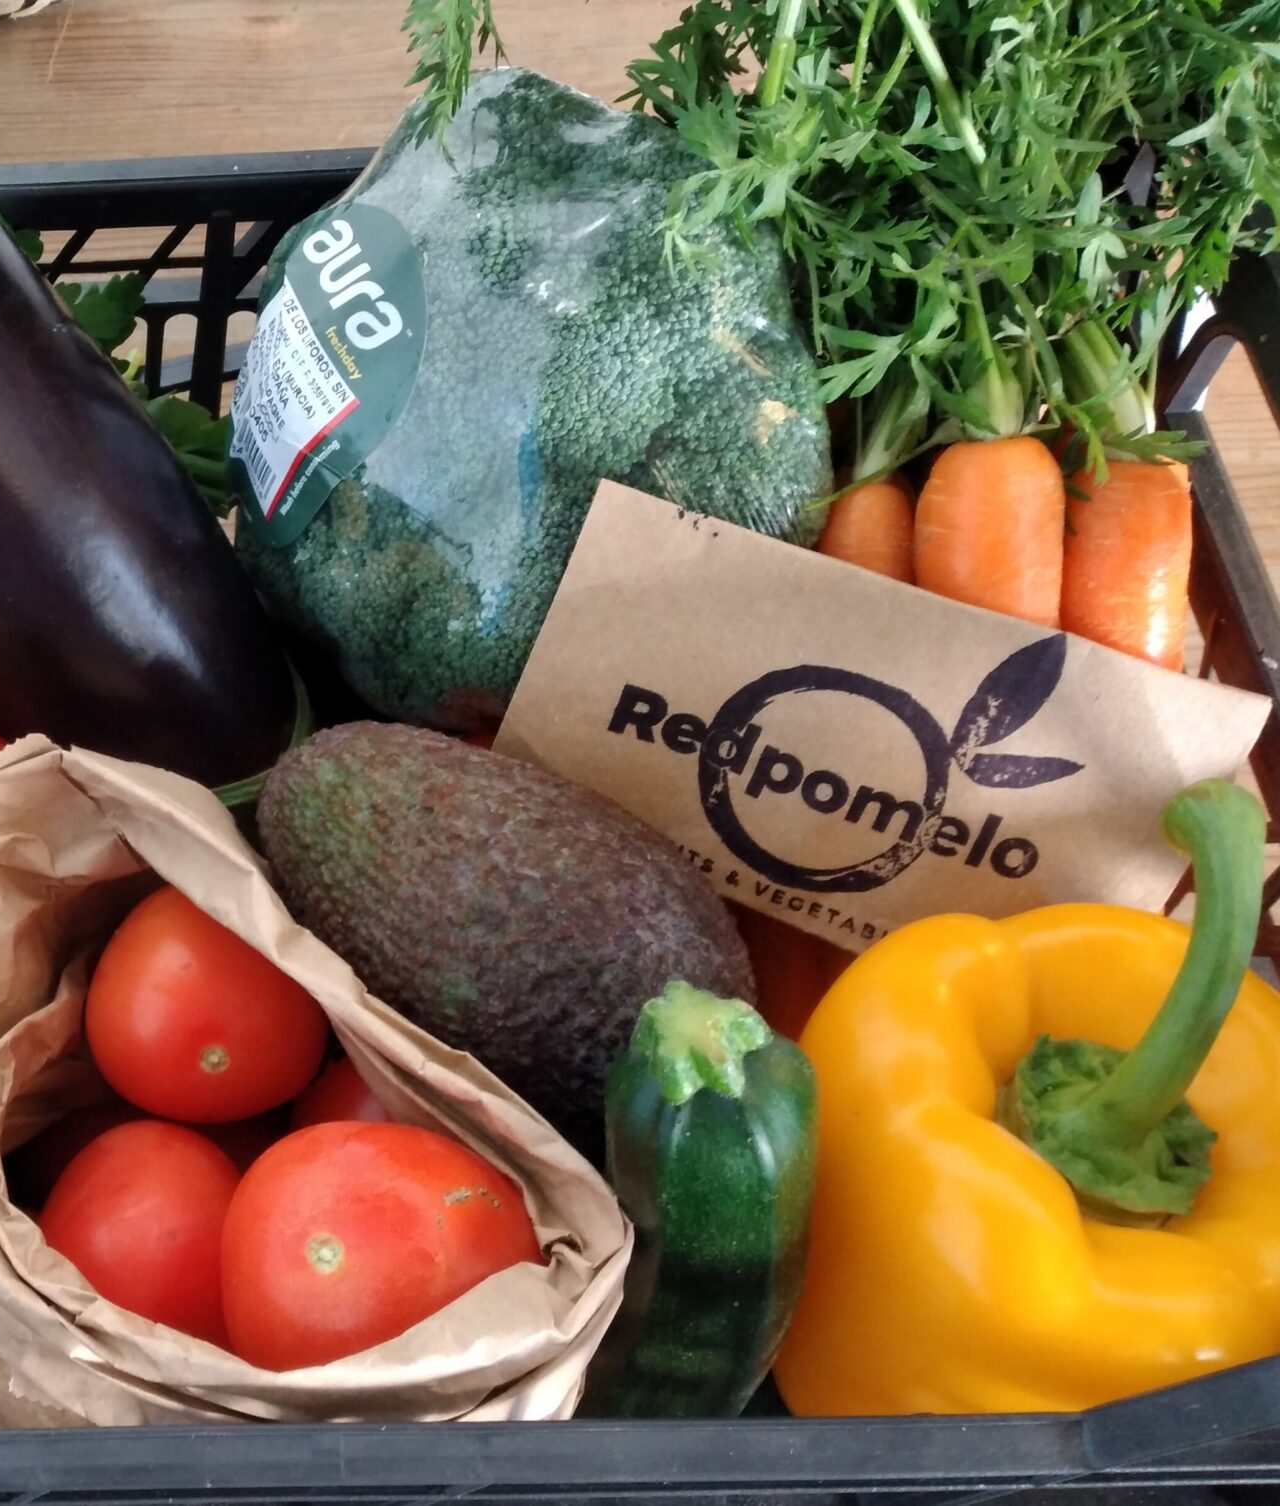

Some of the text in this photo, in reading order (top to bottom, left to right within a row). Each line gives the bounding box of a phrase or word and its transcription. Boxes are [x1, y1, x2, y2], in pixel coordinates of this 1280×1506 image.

[283, 298, 298, 315] DE
[302, 219, 404, 350] aura
[290, 313, 308, 336] LOS
[325, 325, 362, 380] freshday
[281, 368, 316, 420] (MURCIA)
[331, 381, 350, 404] S/N
[607, 683, 1039, 880] Redpomelo
[724, 870, 739, 887] &
[753, 880, 888, 940] VEGETAB
